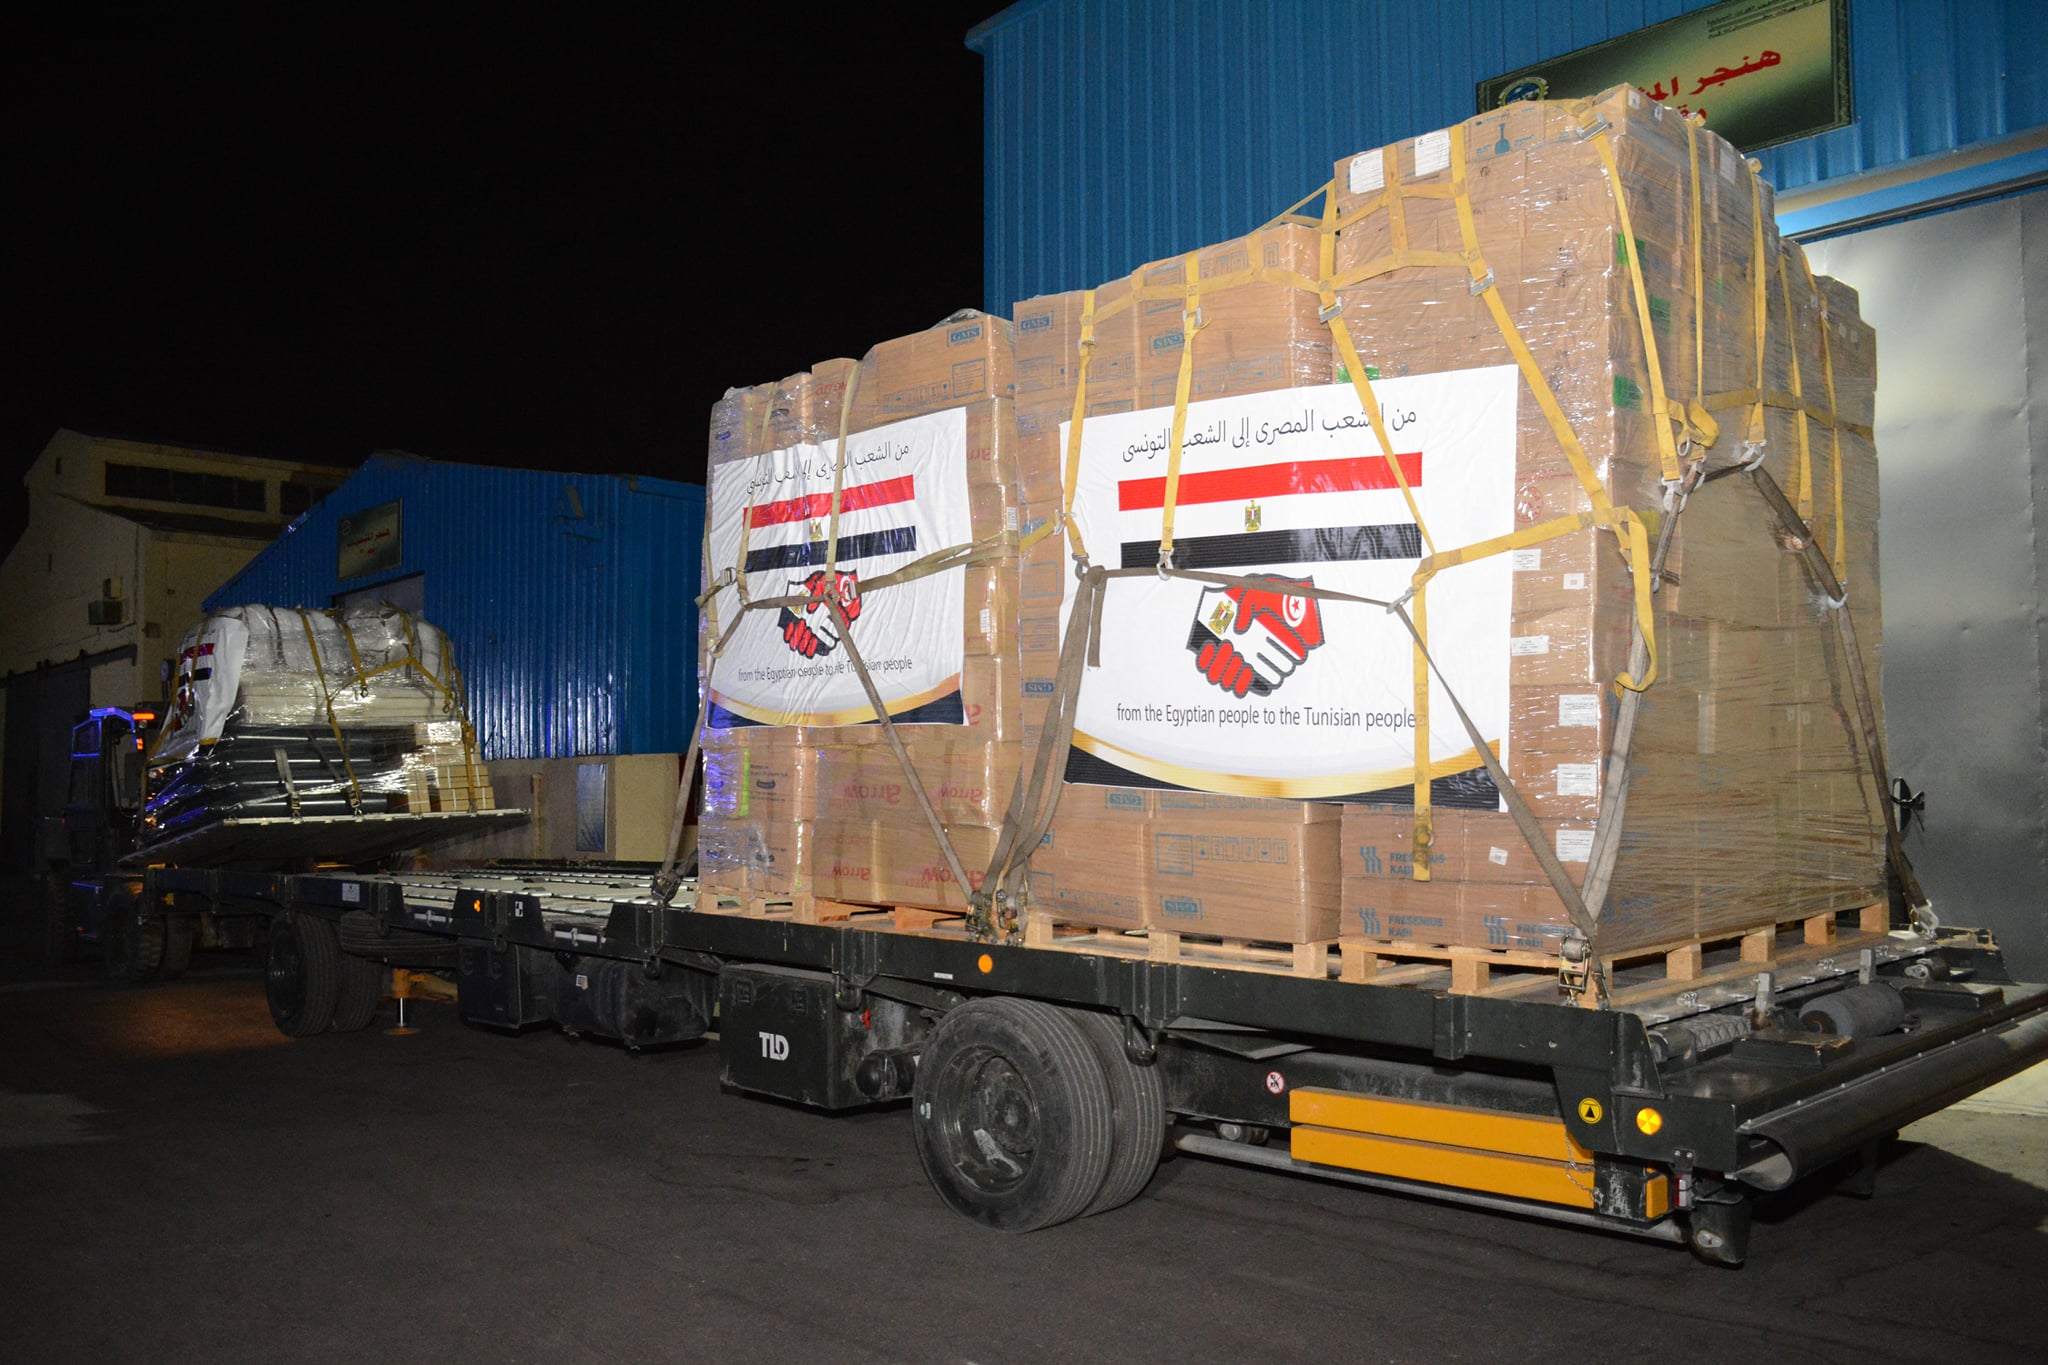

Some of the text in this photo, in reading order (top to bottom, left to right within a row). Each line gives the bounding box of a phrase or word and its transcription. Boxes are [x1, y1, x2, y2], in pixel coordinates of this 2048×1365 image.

[1689, 50, 1781, 96] هنجر
[1232, 416, 1250, 448] إلى
[1256, 409, 1314, 446] المصرى
[1322, 402, 1384, 438] اشعب
[1392, 408, 1417, 431] من
[855, 441, 891, 471] الشعب
[895, 444, 909, 462] من
[754, 667, 765, 681] the
[1117, 702, 1416, 733] from the Egyptian people to the Tunisian people
[759, 1031, 790, 1061] TLD
